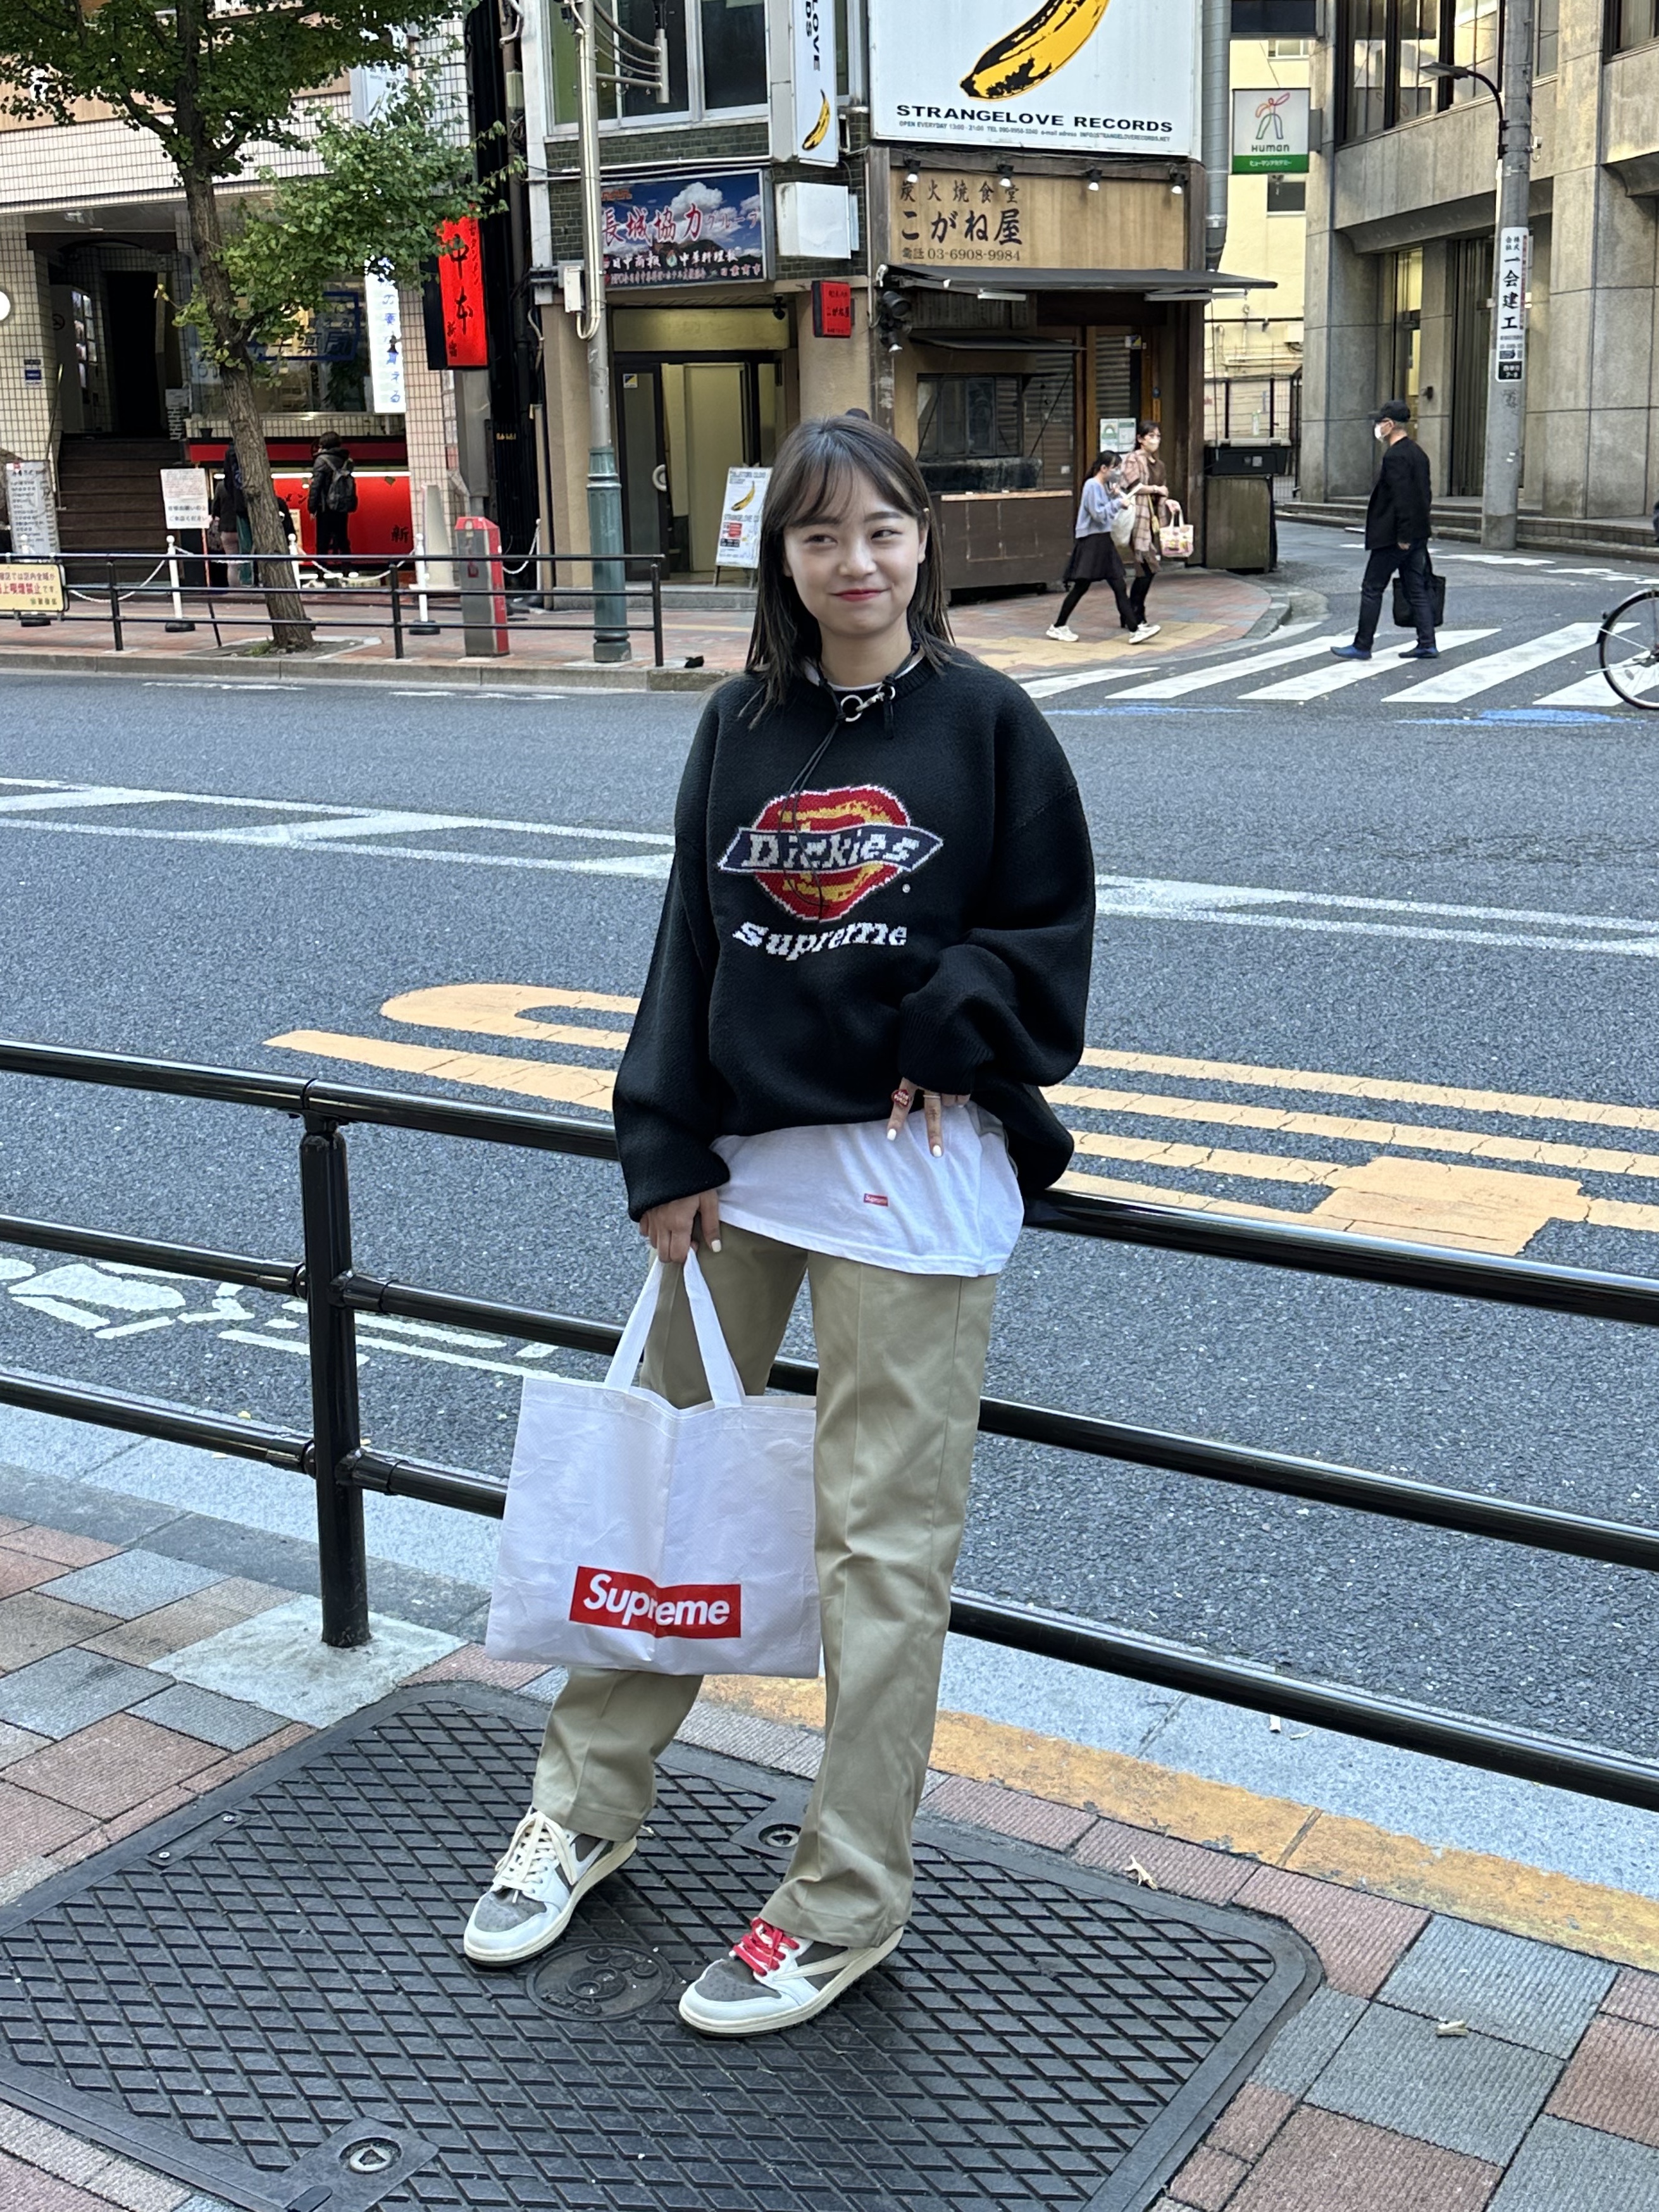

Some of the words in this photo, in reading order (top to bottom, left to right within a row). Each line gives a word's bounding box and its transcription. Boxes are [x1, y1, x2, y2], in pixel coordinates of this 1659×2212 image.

[897, 105, 1064, 126] STRANGELOVE
[1074, 116, 1172, 132] RECORDS
[901, 208, 1022, 245] こがね屋
[928, 248, 1021, 261] 03-6908-9984
[1501, 256, 1521, 330] 一会建工
[742, 829, 921, 869] Dickies
[732, 921, 907, 961] Supreme
[583, 1573, 730, 1626] Supreme
